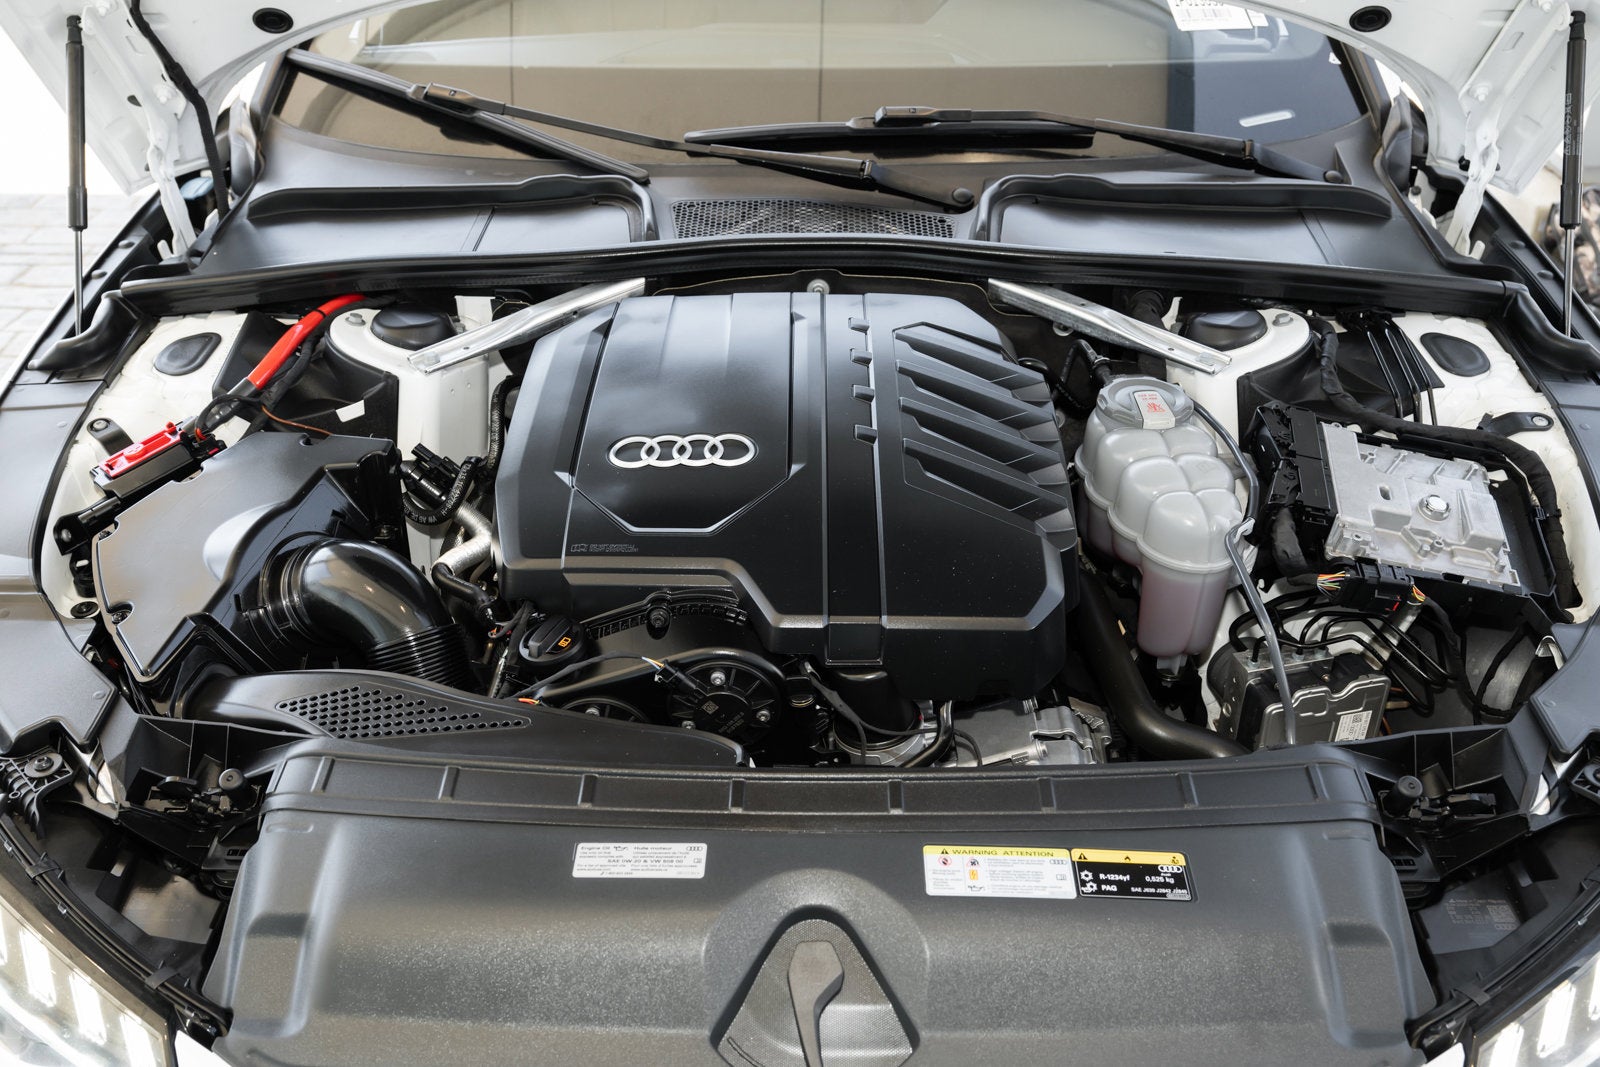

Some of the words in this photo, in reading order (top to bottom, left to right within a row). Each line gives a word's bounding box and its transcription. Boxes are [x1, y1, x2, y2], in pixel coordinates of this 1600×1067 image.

[1099, 873, 1131, 882] R-1234yf
[1165, 876, 1175, 884] kg
[1101, 884, 1118, 892] PAG
